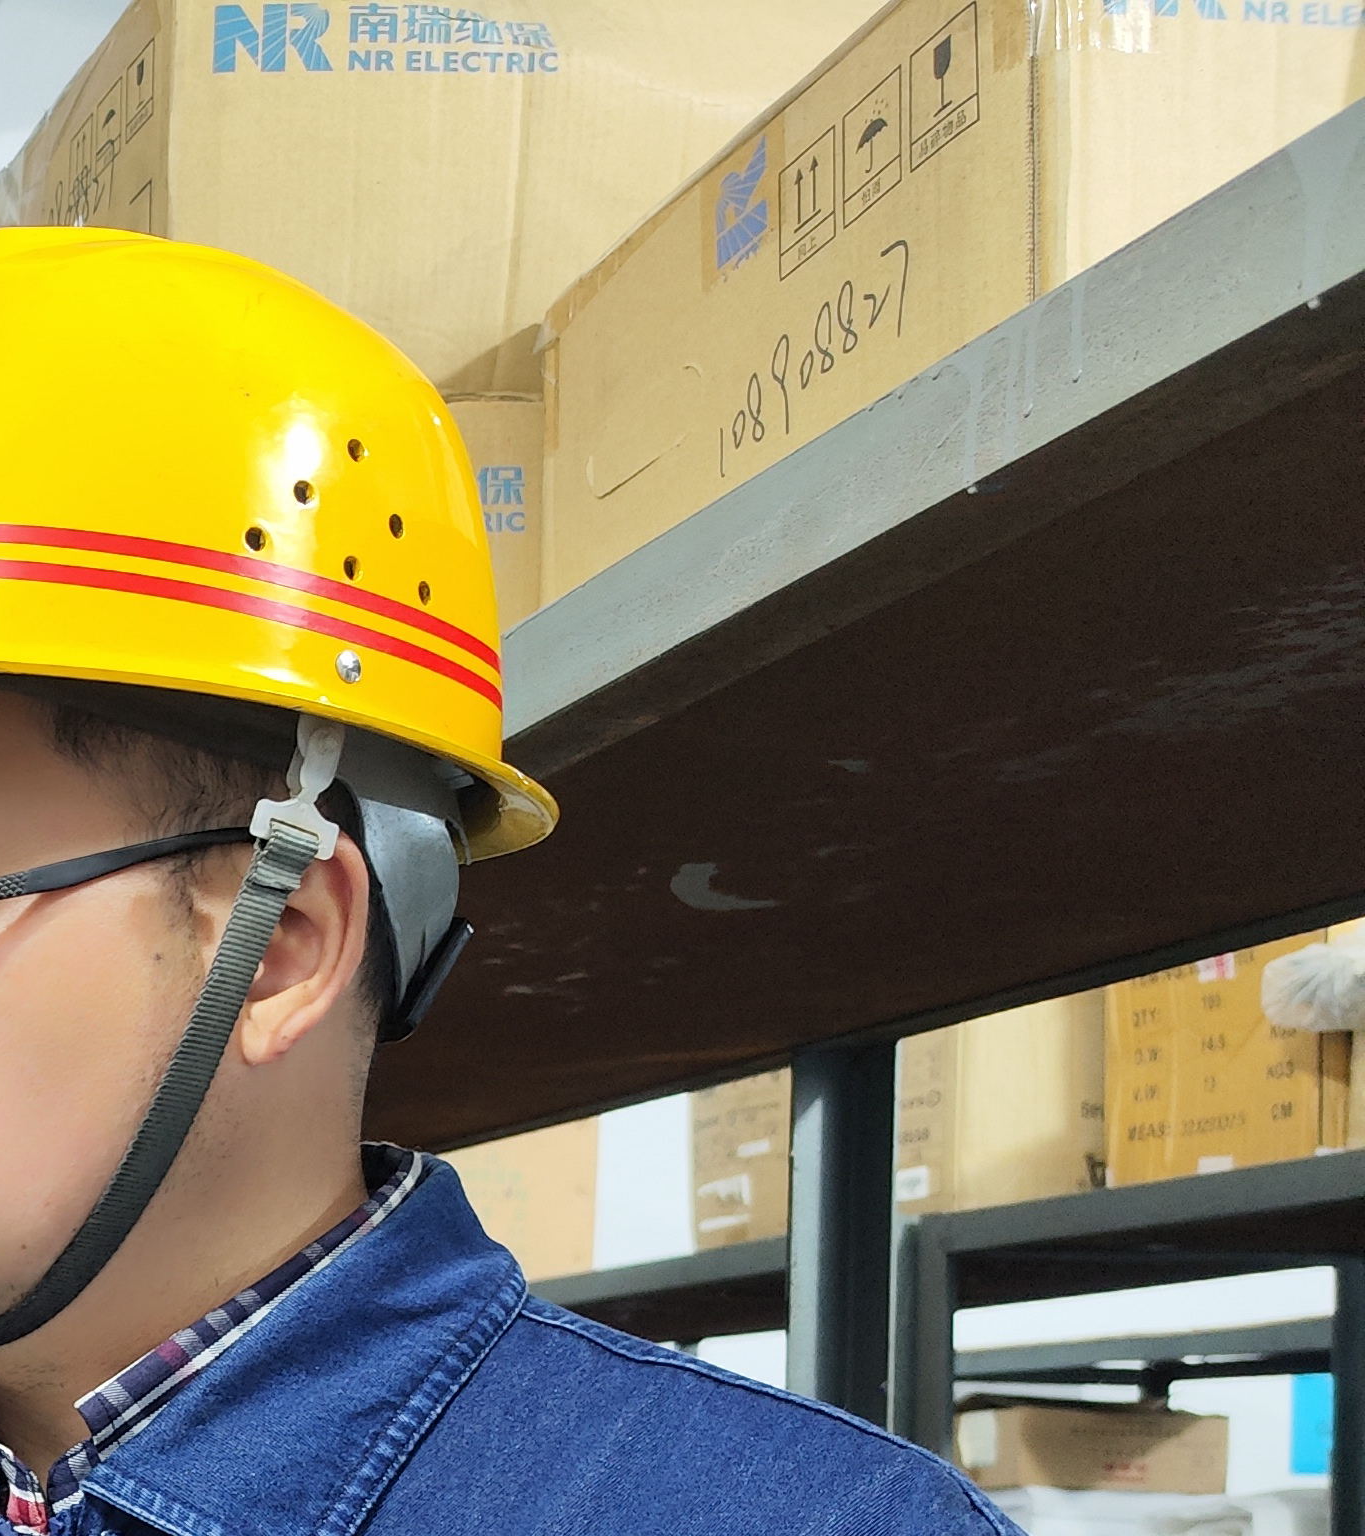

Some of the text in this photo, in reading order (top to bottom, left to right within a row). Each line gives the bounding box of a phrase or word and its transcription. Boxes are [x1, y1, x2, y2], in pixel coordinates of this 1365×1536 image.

[1244, 0, 1289, 24] NR
[1302, 3, 1365, 28] ELE
[348, 50, 559, 73] NR ELECTRIC
